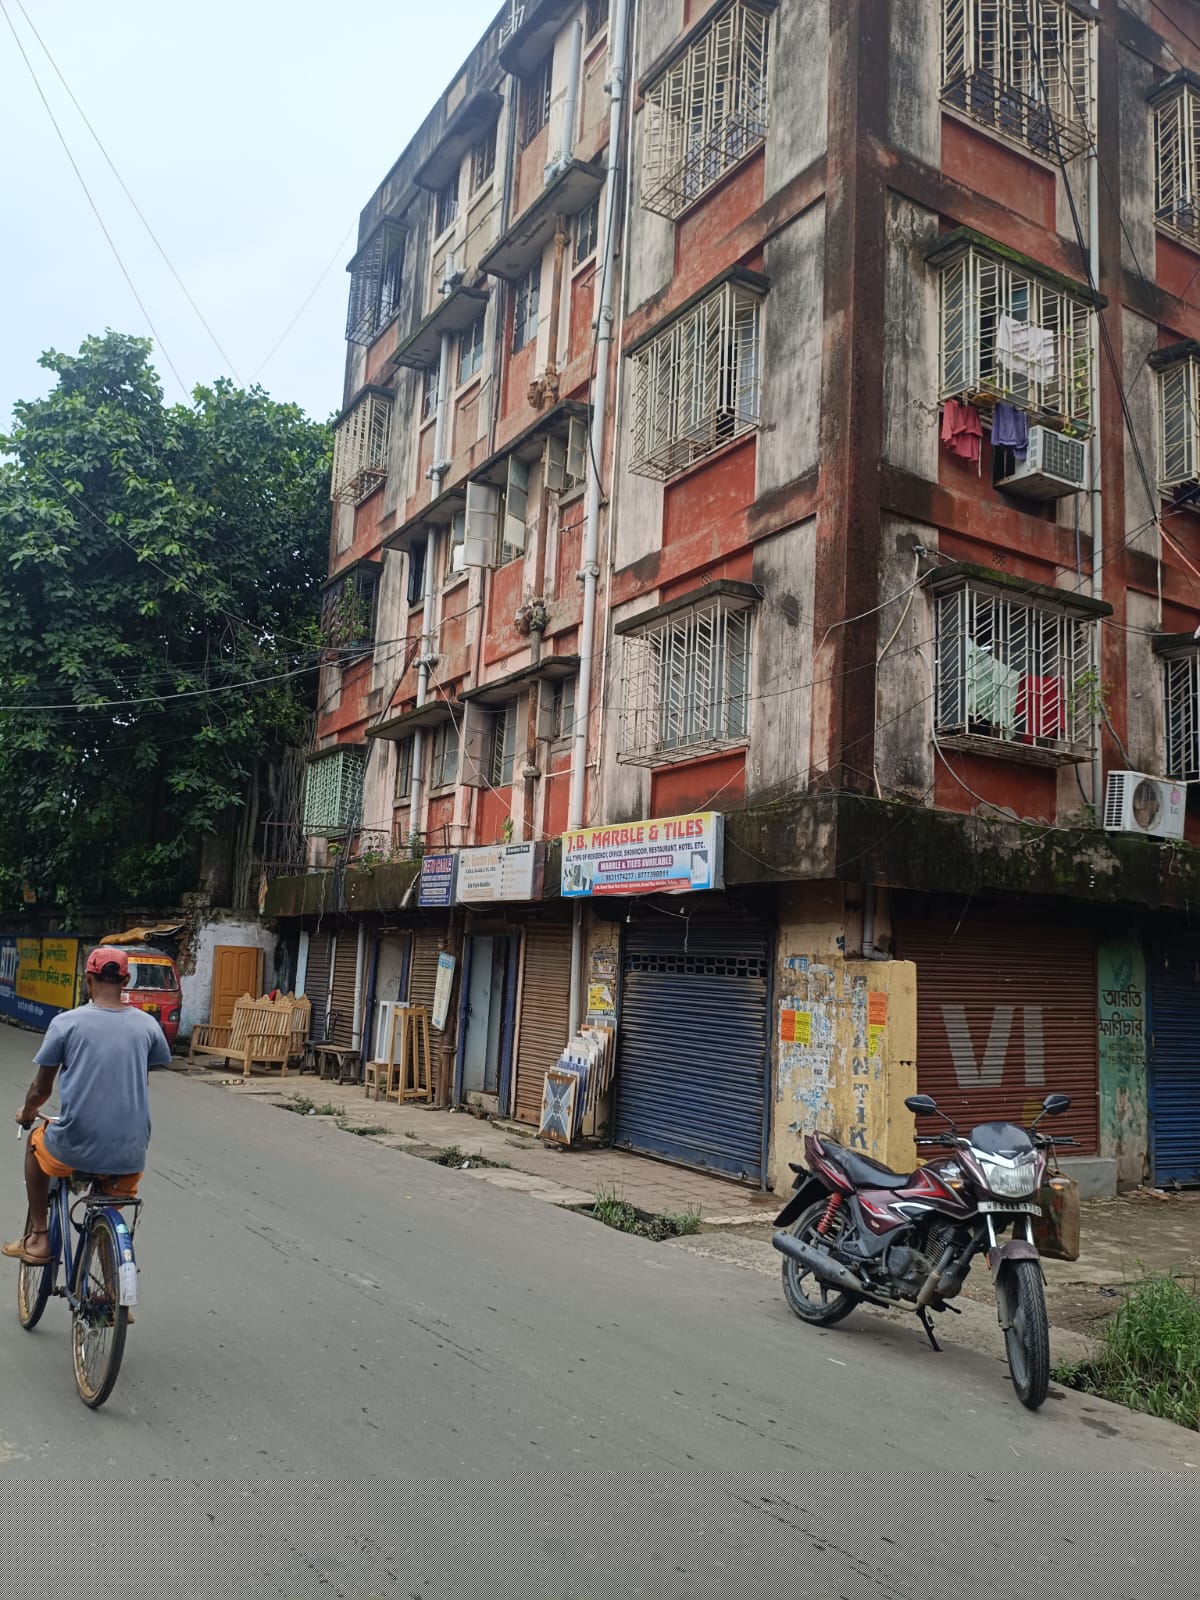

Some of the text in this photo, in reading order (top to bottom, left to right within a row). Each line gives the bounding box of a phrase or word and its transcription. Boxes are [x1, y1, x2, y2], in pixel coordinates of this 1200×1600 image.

[568, 818, 703, 853] J.B. MARBLE & TILES
[627, 858, 641, 868] TILES
[641, 855, 672, 867] AVAILABLE
[1101, 984, 1143, 1008] আরতি
[941, 1004, 1045, 1089] VI
